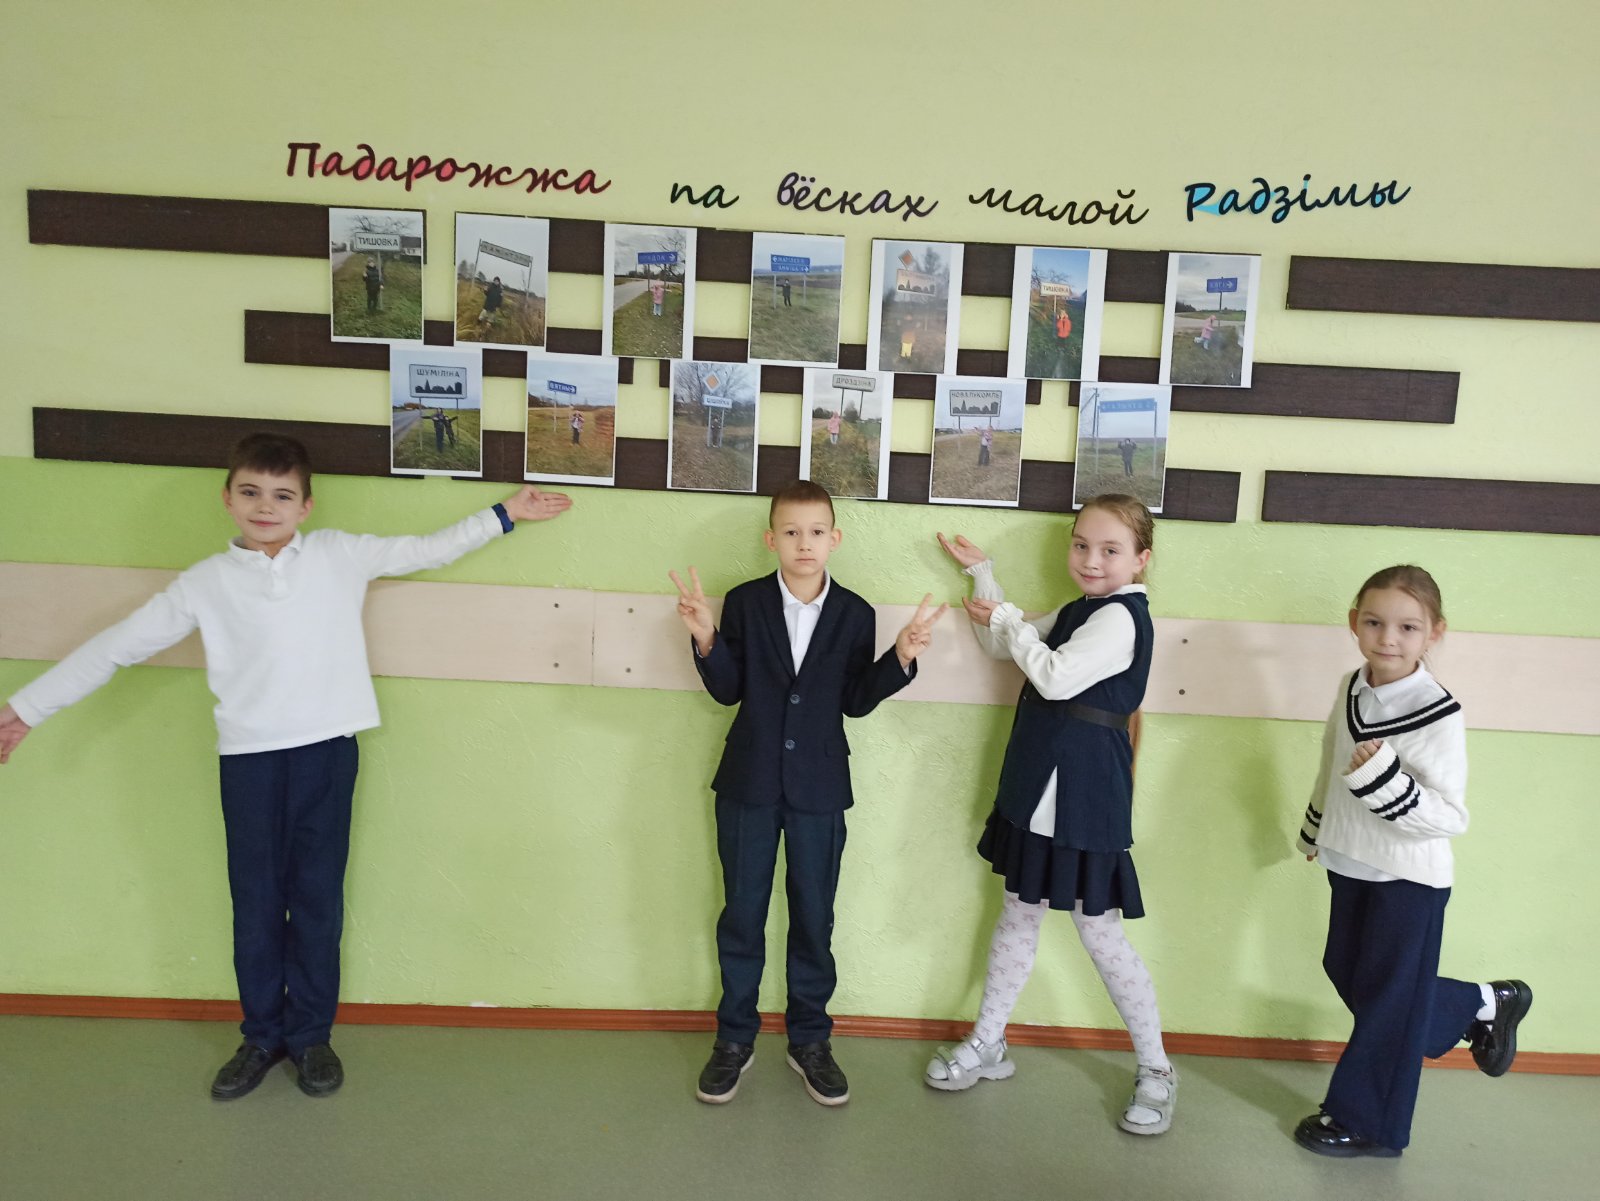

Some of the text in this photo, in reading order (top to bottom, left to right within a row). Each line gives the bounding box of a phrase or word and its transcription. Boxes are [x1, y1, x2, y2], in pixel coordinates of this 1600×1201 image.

[287, 143, 1411, 225] Падарожжа па вёсках малой Радзімы
[358, 237, 399, 247] ТИШОВКА
[416, 368, 461, 378] ШУМІЛІНА
